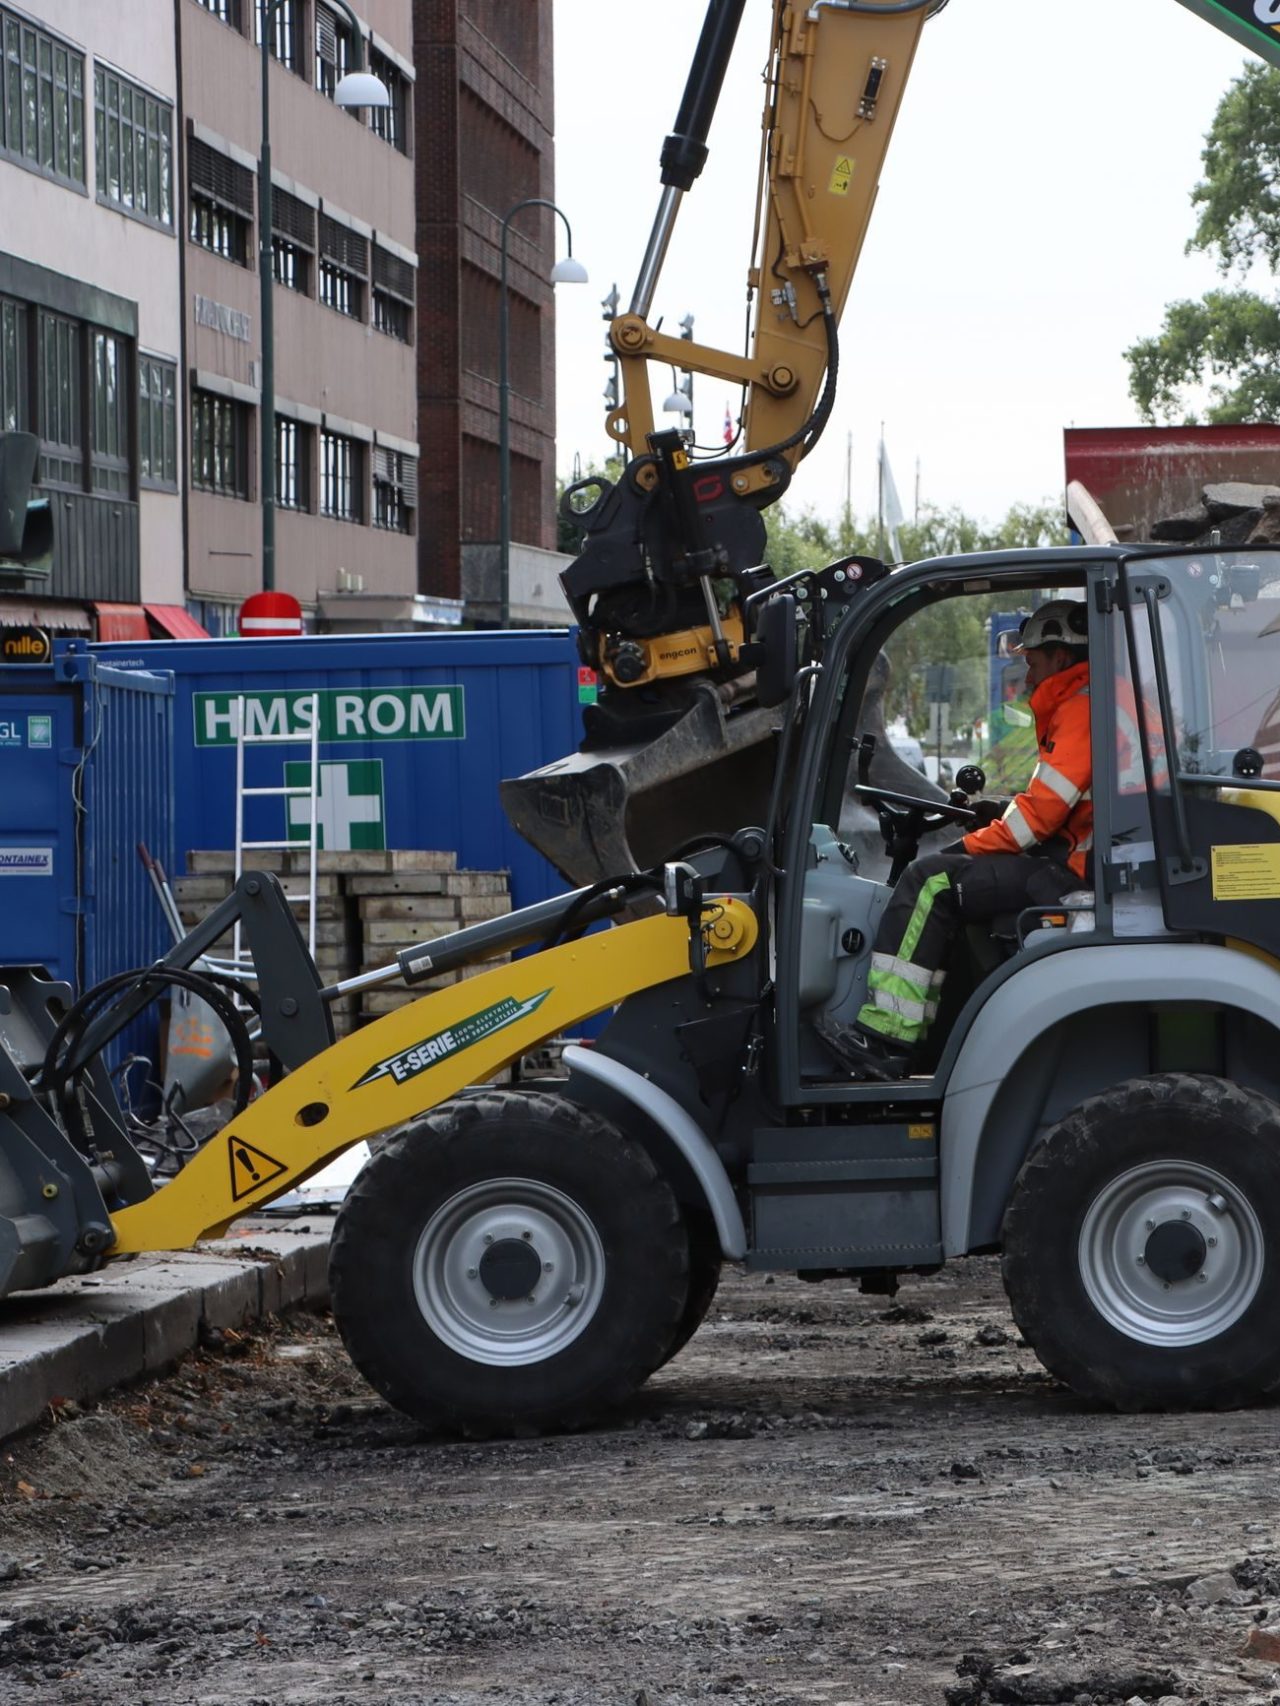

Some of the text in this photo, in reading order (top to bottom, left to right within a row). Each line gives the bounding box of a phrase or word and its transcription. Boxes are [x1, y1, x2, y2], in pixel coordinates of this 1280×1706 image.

[5, 636, 44, 654] nille
[660, 648, 697, 660] engcon
[205, 693, 453, 739] HMS ROM
[390, 1031, 457, 1081] E-SERIE
